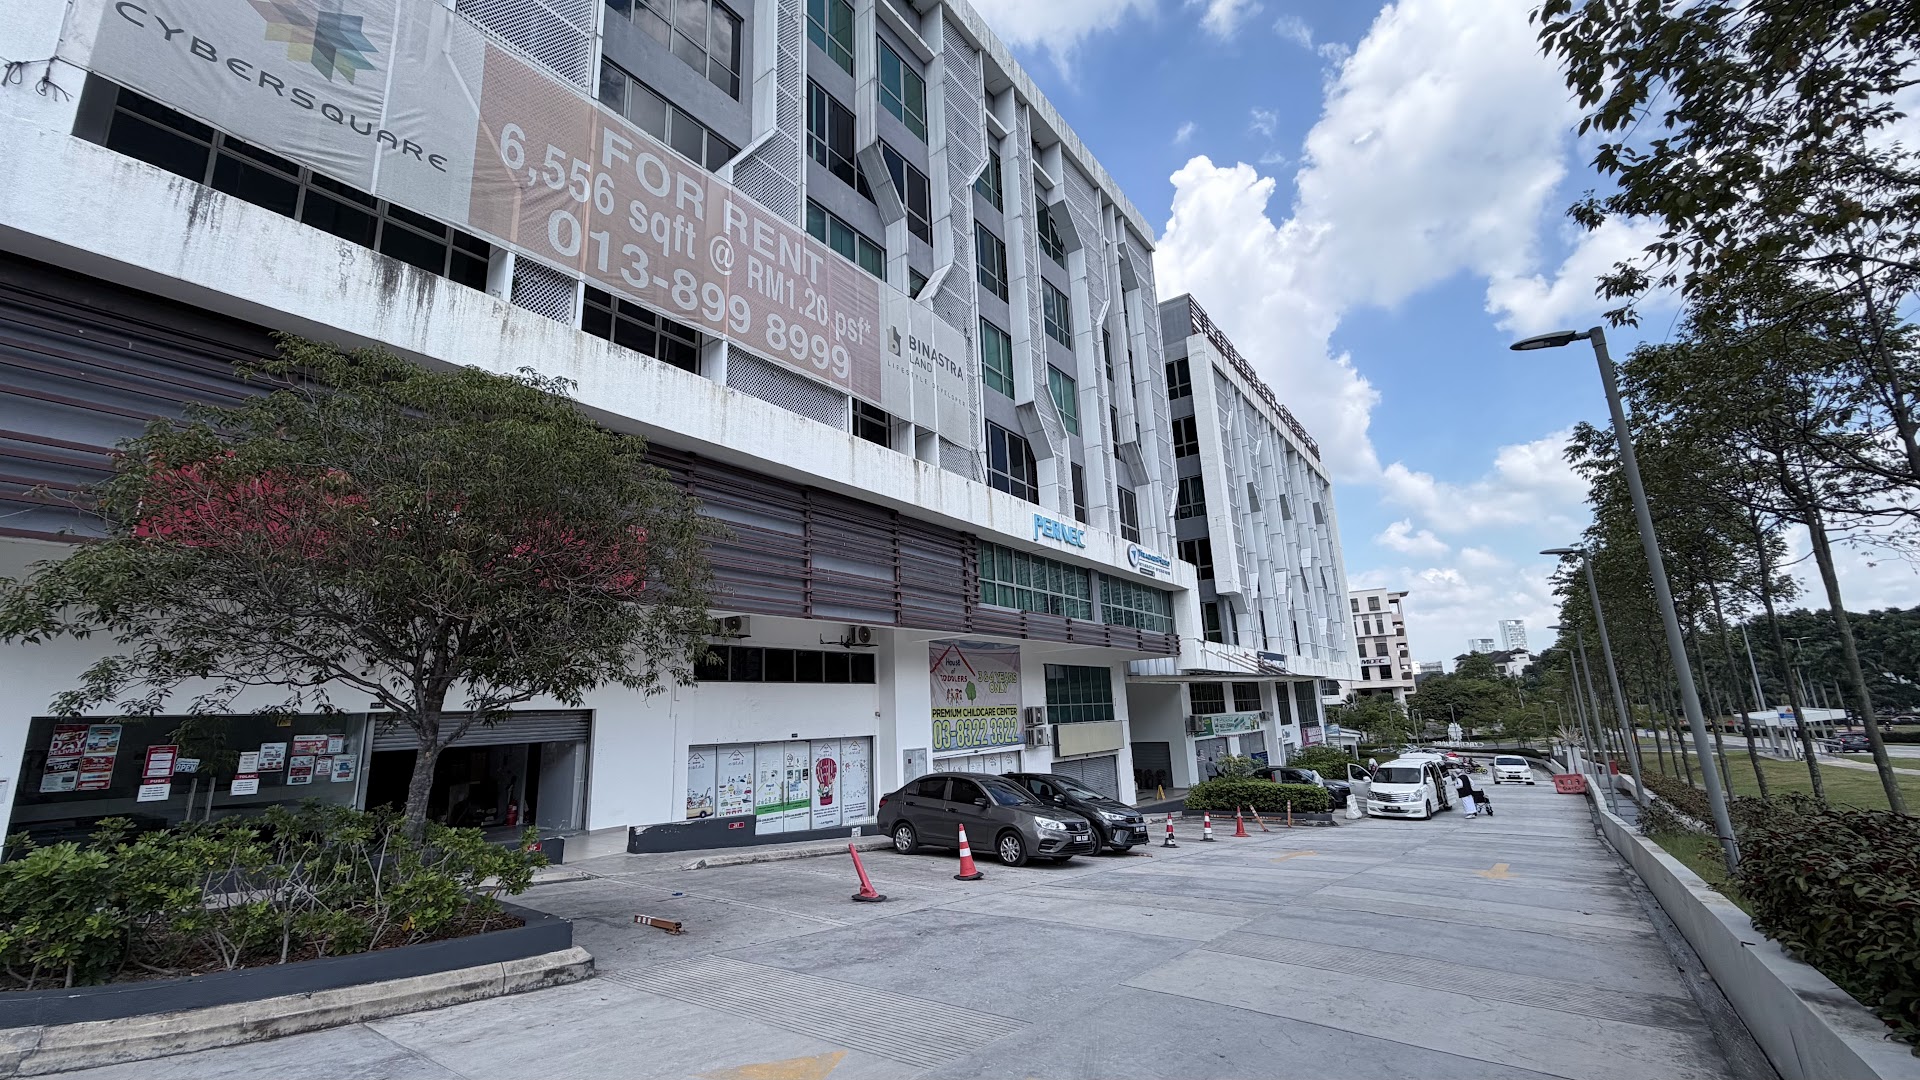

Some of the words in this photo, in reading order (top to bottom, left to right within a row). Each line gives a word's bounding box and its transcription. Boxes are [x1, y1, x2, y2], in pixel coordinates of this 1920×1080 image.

[114, 1, 449, 173] CYBERSQUARE
[601, 126, 706, 221] FOR
[722, 198, 825, 285] RENT
[499, 122, 616, 216] 6,556
[628, 198, 697, 260] sqft
[708, 235, 736, 276] @
[747, 254, 829, 327] RM1.20
[546, 208, 751, 335] 013-899
[765, 314, 853, 381] 8999
[908, 334, 964, 381] BINASTRA
[909, 352, 933, 373] LAND
[887, 360, 928, 385] LIFESTYLE
[932, 383, 966, 408] DEVELOPER
[1033, 513, 1086, 549] PERNEC
[945, 657, 961, 667] House
[989, 681, 1009, 694] ONLY
[994, 671, 1018, 684] YEARS
[932, 708, 962, 718] PREMIUM
[962, 707, 996, 717] CHILDCARE
[996, 707, 1018, 716] CENTER
[52, 731, 88, 741] NEXT
[933, 718, 988, 749] 03-8322
[990, 717, 1018, 744] 3322
[48, 748, 85, 756] DELIVERY
[50, 738, 86, 751] DAY
[175, 764, 197, 772] OPEN
